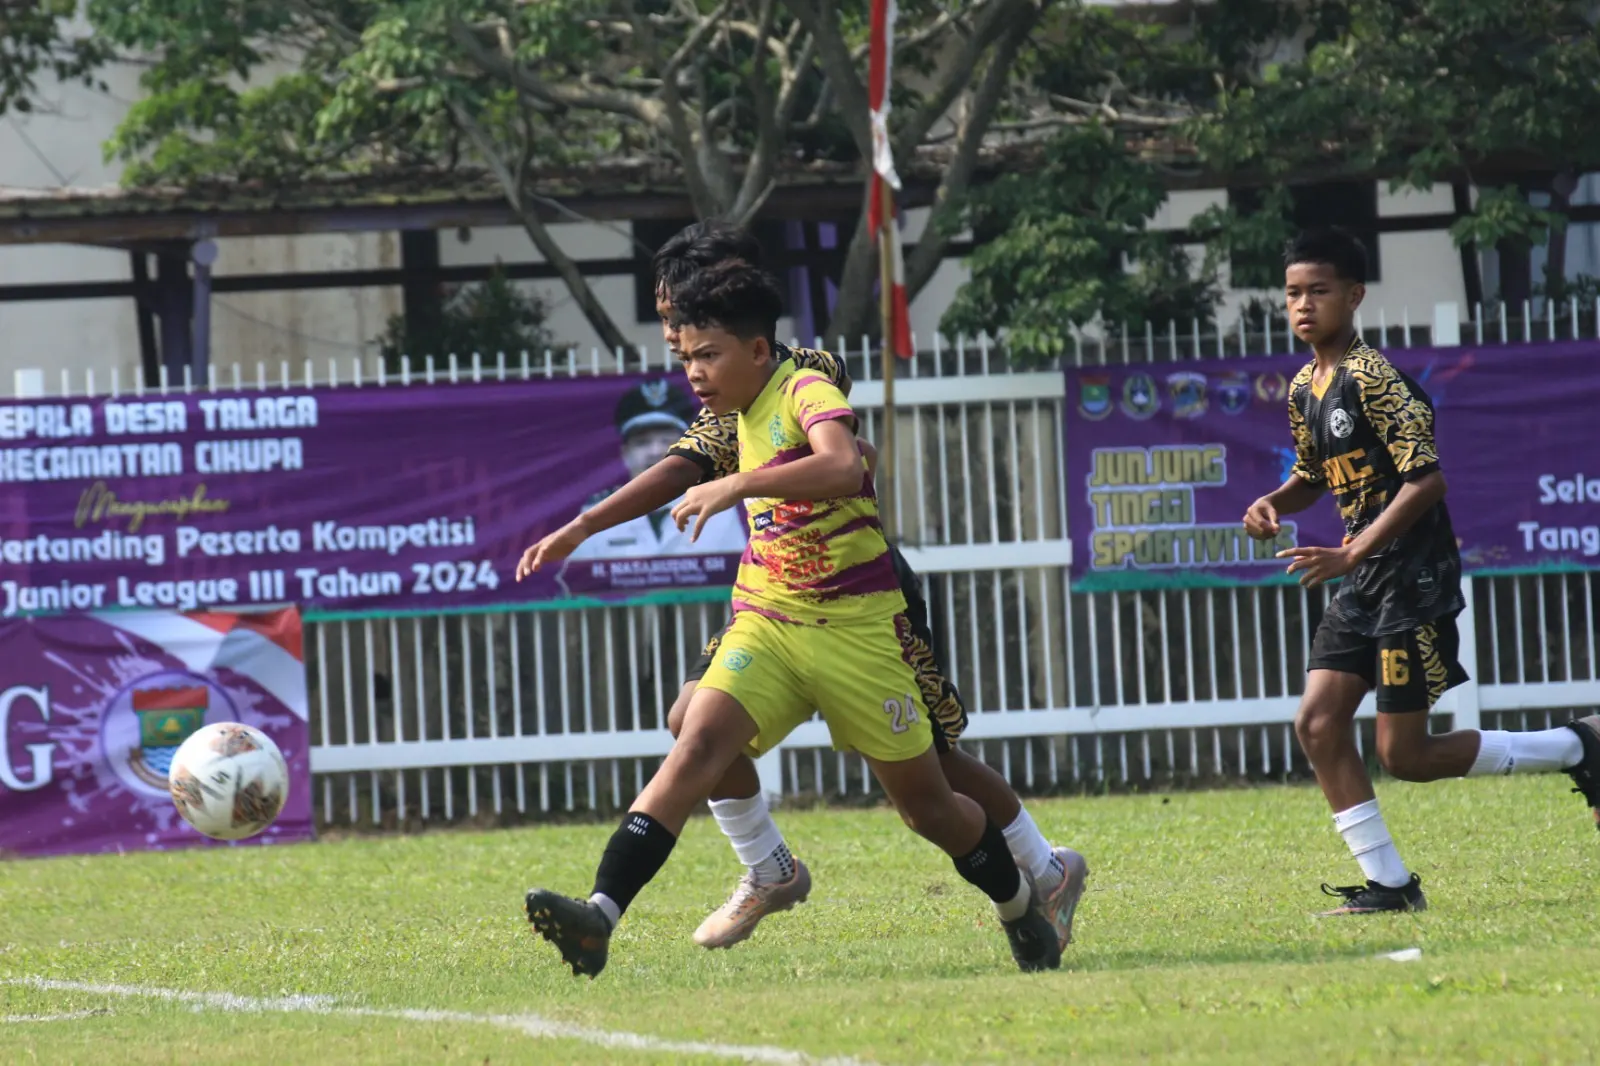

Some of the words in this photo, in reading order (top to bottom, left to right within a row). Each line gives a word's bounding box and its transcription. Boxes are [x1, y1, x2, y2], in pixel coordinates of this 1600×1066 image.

[105, 401, 187, 435] DESA
[198, 396, 318, 431] TALAGA
[194, 437, 303, 474] CIKUPA
[1087, 446, 1227, 487] JUNJUNG
[1089, 486, 1194, 528] TINGGI
[0, 529, 165, 565] ertanding
[176, 525, 299, 558] Peserta
[312, 516, 475, 556] Kompetisi
[1517, 521, 1600, 557] Tang
[784, 556, 834, 579] SRC
[2, 580, 106, 617] Junior
[117, 576, 238, 612] League
[249, 570, 285, 601] III
[295, 567, 401, 599] Tahun
[411, 560, 499, 594] 2024
[1381, 648, 1409, 686] 16
[883, 693, 920, 735] 24
[0, 685, 55, 791] G
